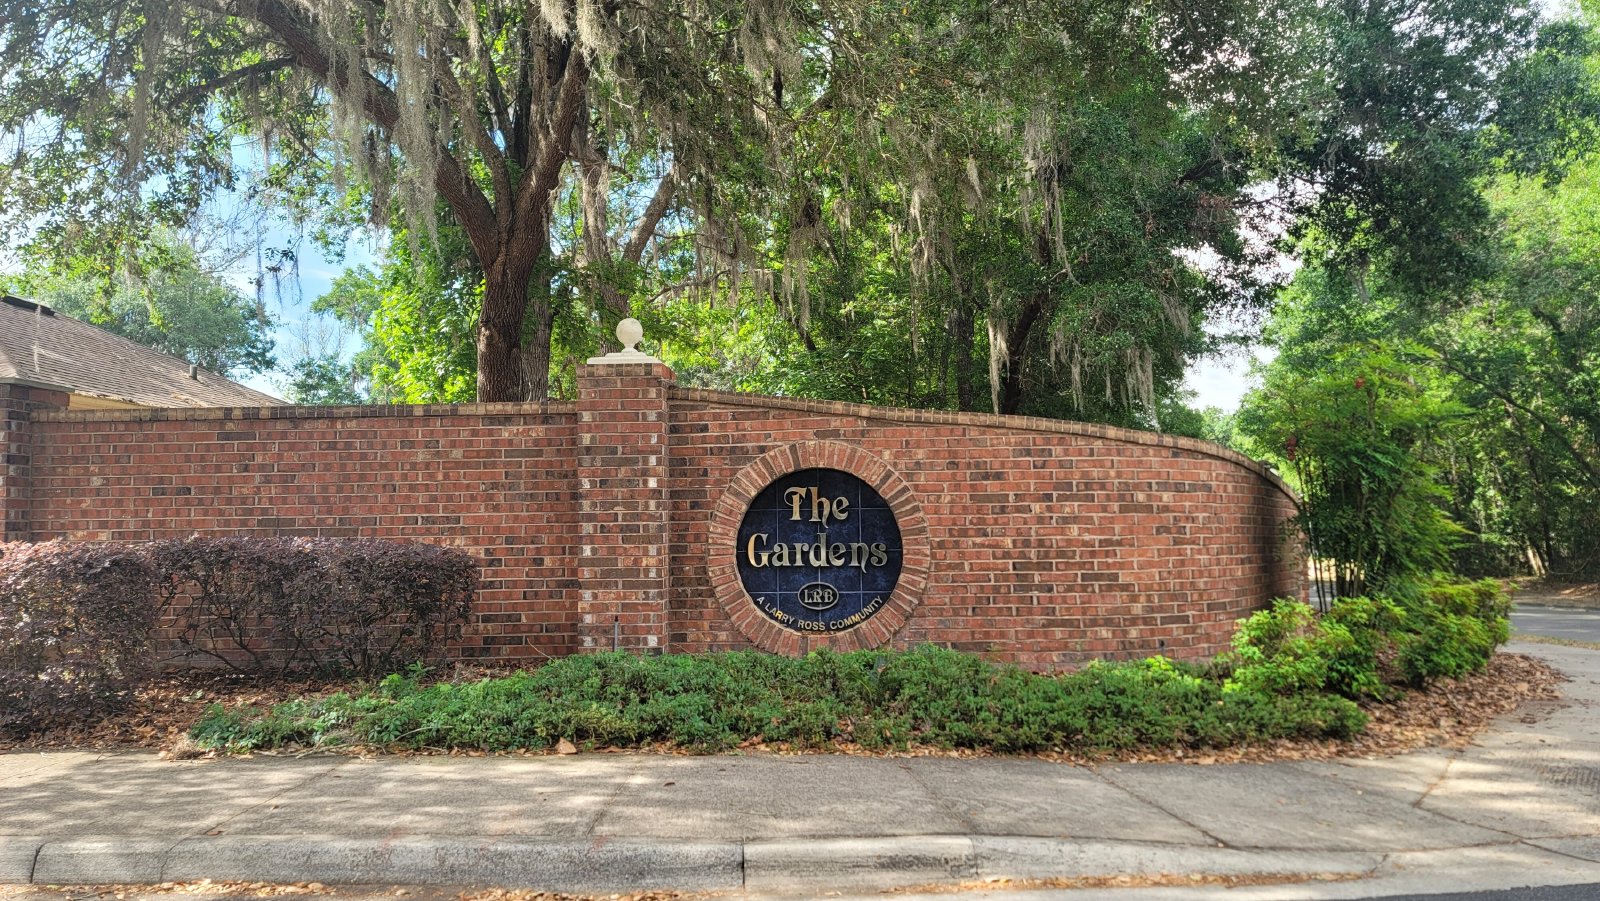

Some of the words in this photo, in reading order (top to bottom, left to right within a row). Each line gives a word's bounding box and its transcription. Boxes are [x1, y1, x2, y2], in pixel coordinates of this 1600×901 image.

[784, 486, 850, 529] The
[747, 532, 888, 574] Gardens
[756, 596, 765, 605] A
[765, 602, 795, 625] LARRY
[797, 620, 826, 631] ROSS
[829, 595, 884, 630] COMMUNITY
[803, 589, 834, 603] LRB
